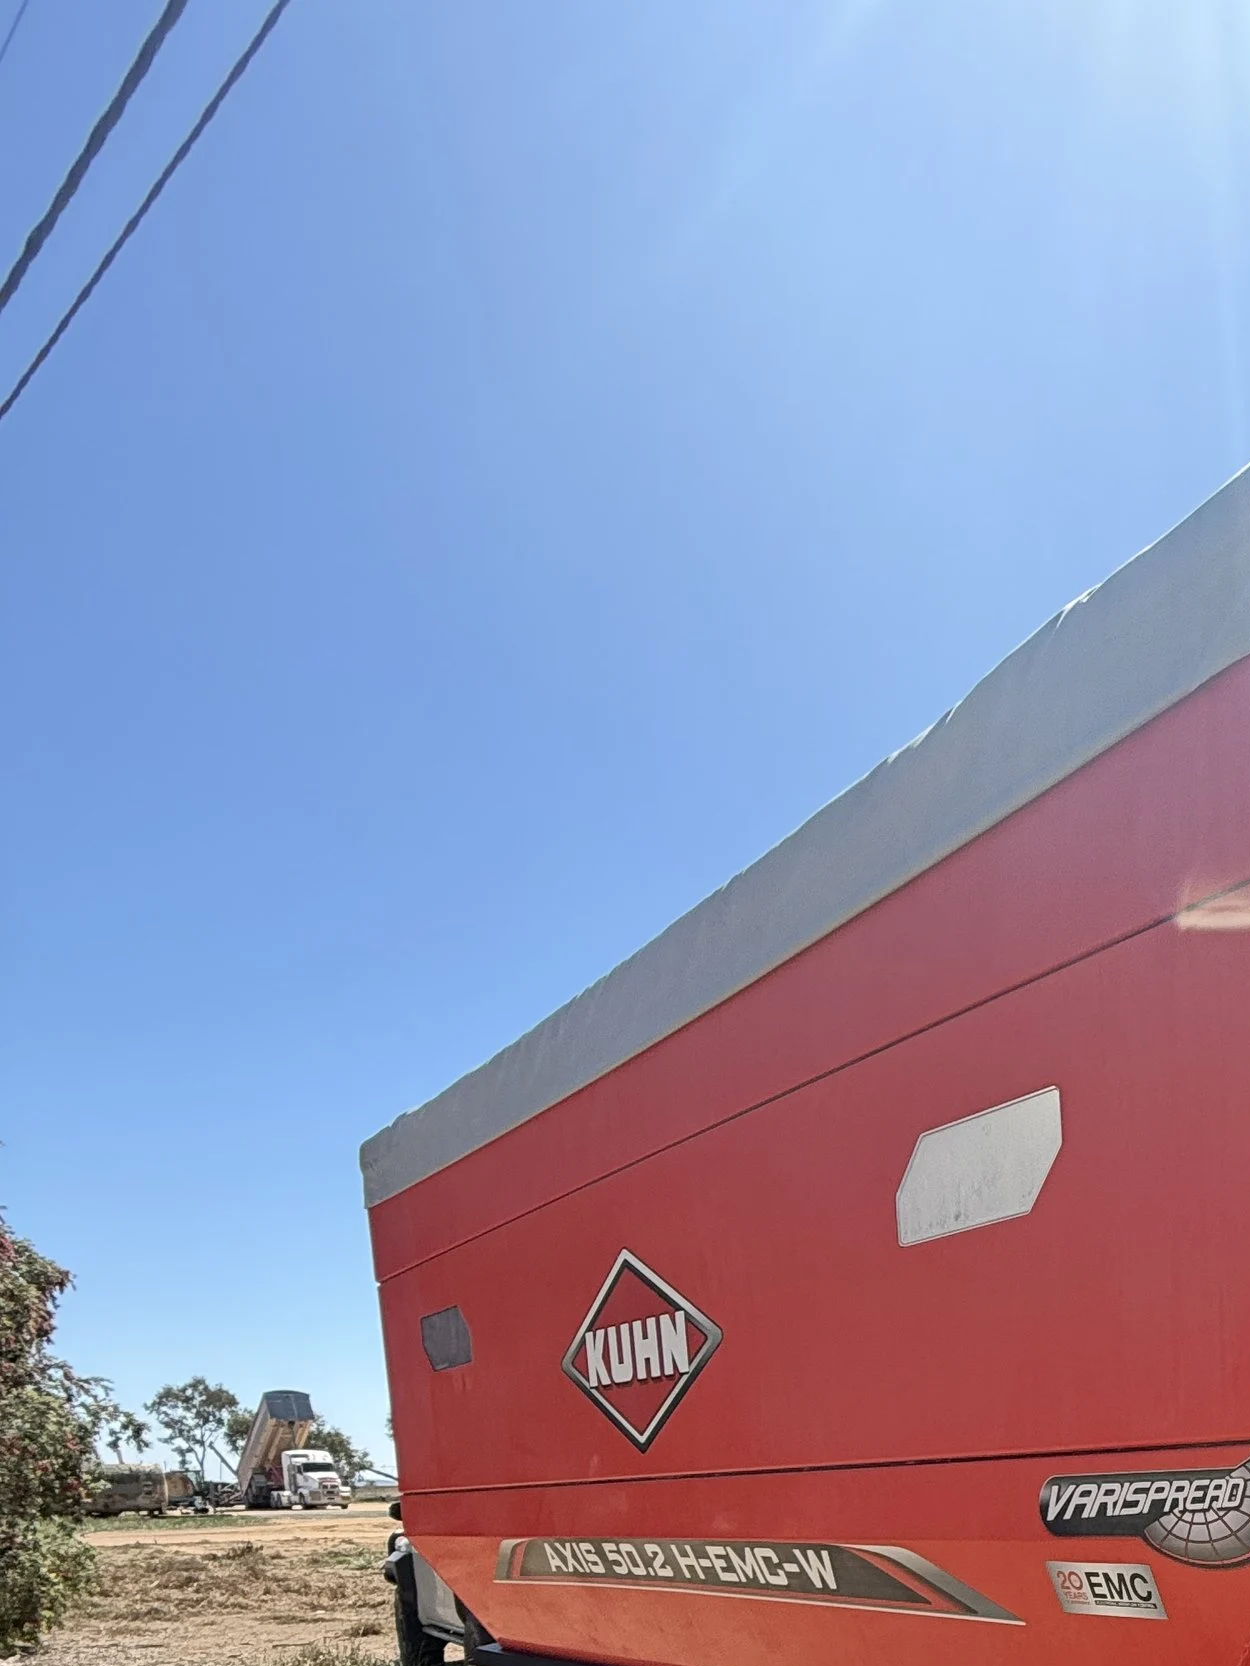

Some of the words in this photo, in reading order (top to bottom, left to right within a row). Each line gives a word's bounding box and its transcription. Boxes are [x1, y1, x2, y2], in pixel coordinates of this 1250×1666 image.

[585, 1310, 690, 1388] KUHN
[1046, 1478, 1246, 1521] VARISPREAD
[543, 1542, 606, 1574] AXIS
[601, 1543, 674, 1577] 50.2
[670, 1544, 838, 1590] H-EMC-W
[1056, 1570, 1084, 1591] 20
[1084, 1571, 1153, 1602] EMC
